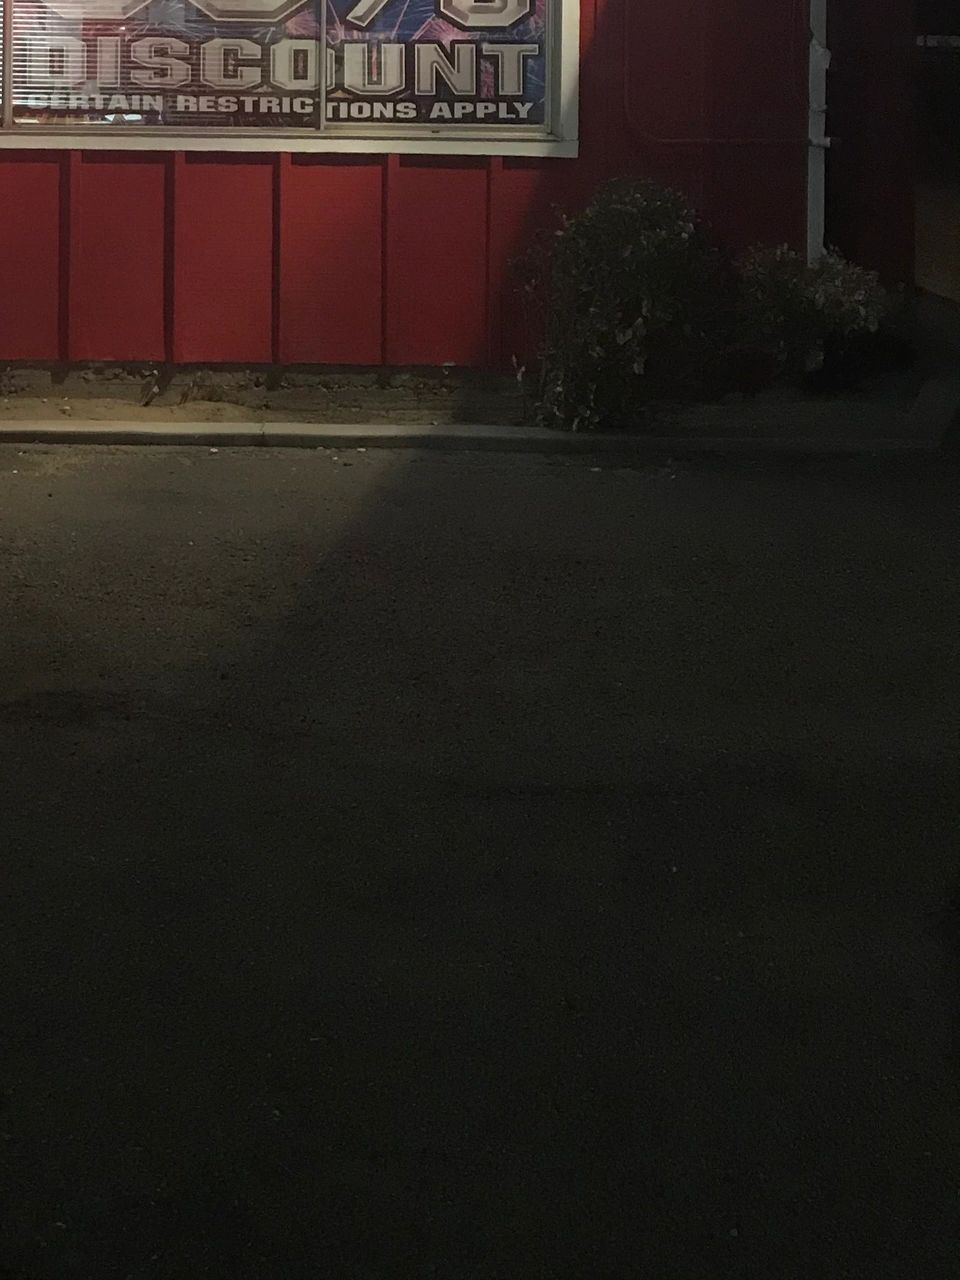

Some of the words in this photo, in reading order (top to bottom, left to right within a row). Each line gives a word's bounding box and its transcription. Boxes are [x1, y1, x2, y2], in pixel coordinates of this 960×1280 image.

[25, 36, 540, 97] DISCOUNT
[27, 94, 163, 112] CERTAIN
[177, 96, 417, 119] RESTRICTIONS
[428, 101, 534, 120] APPLY
